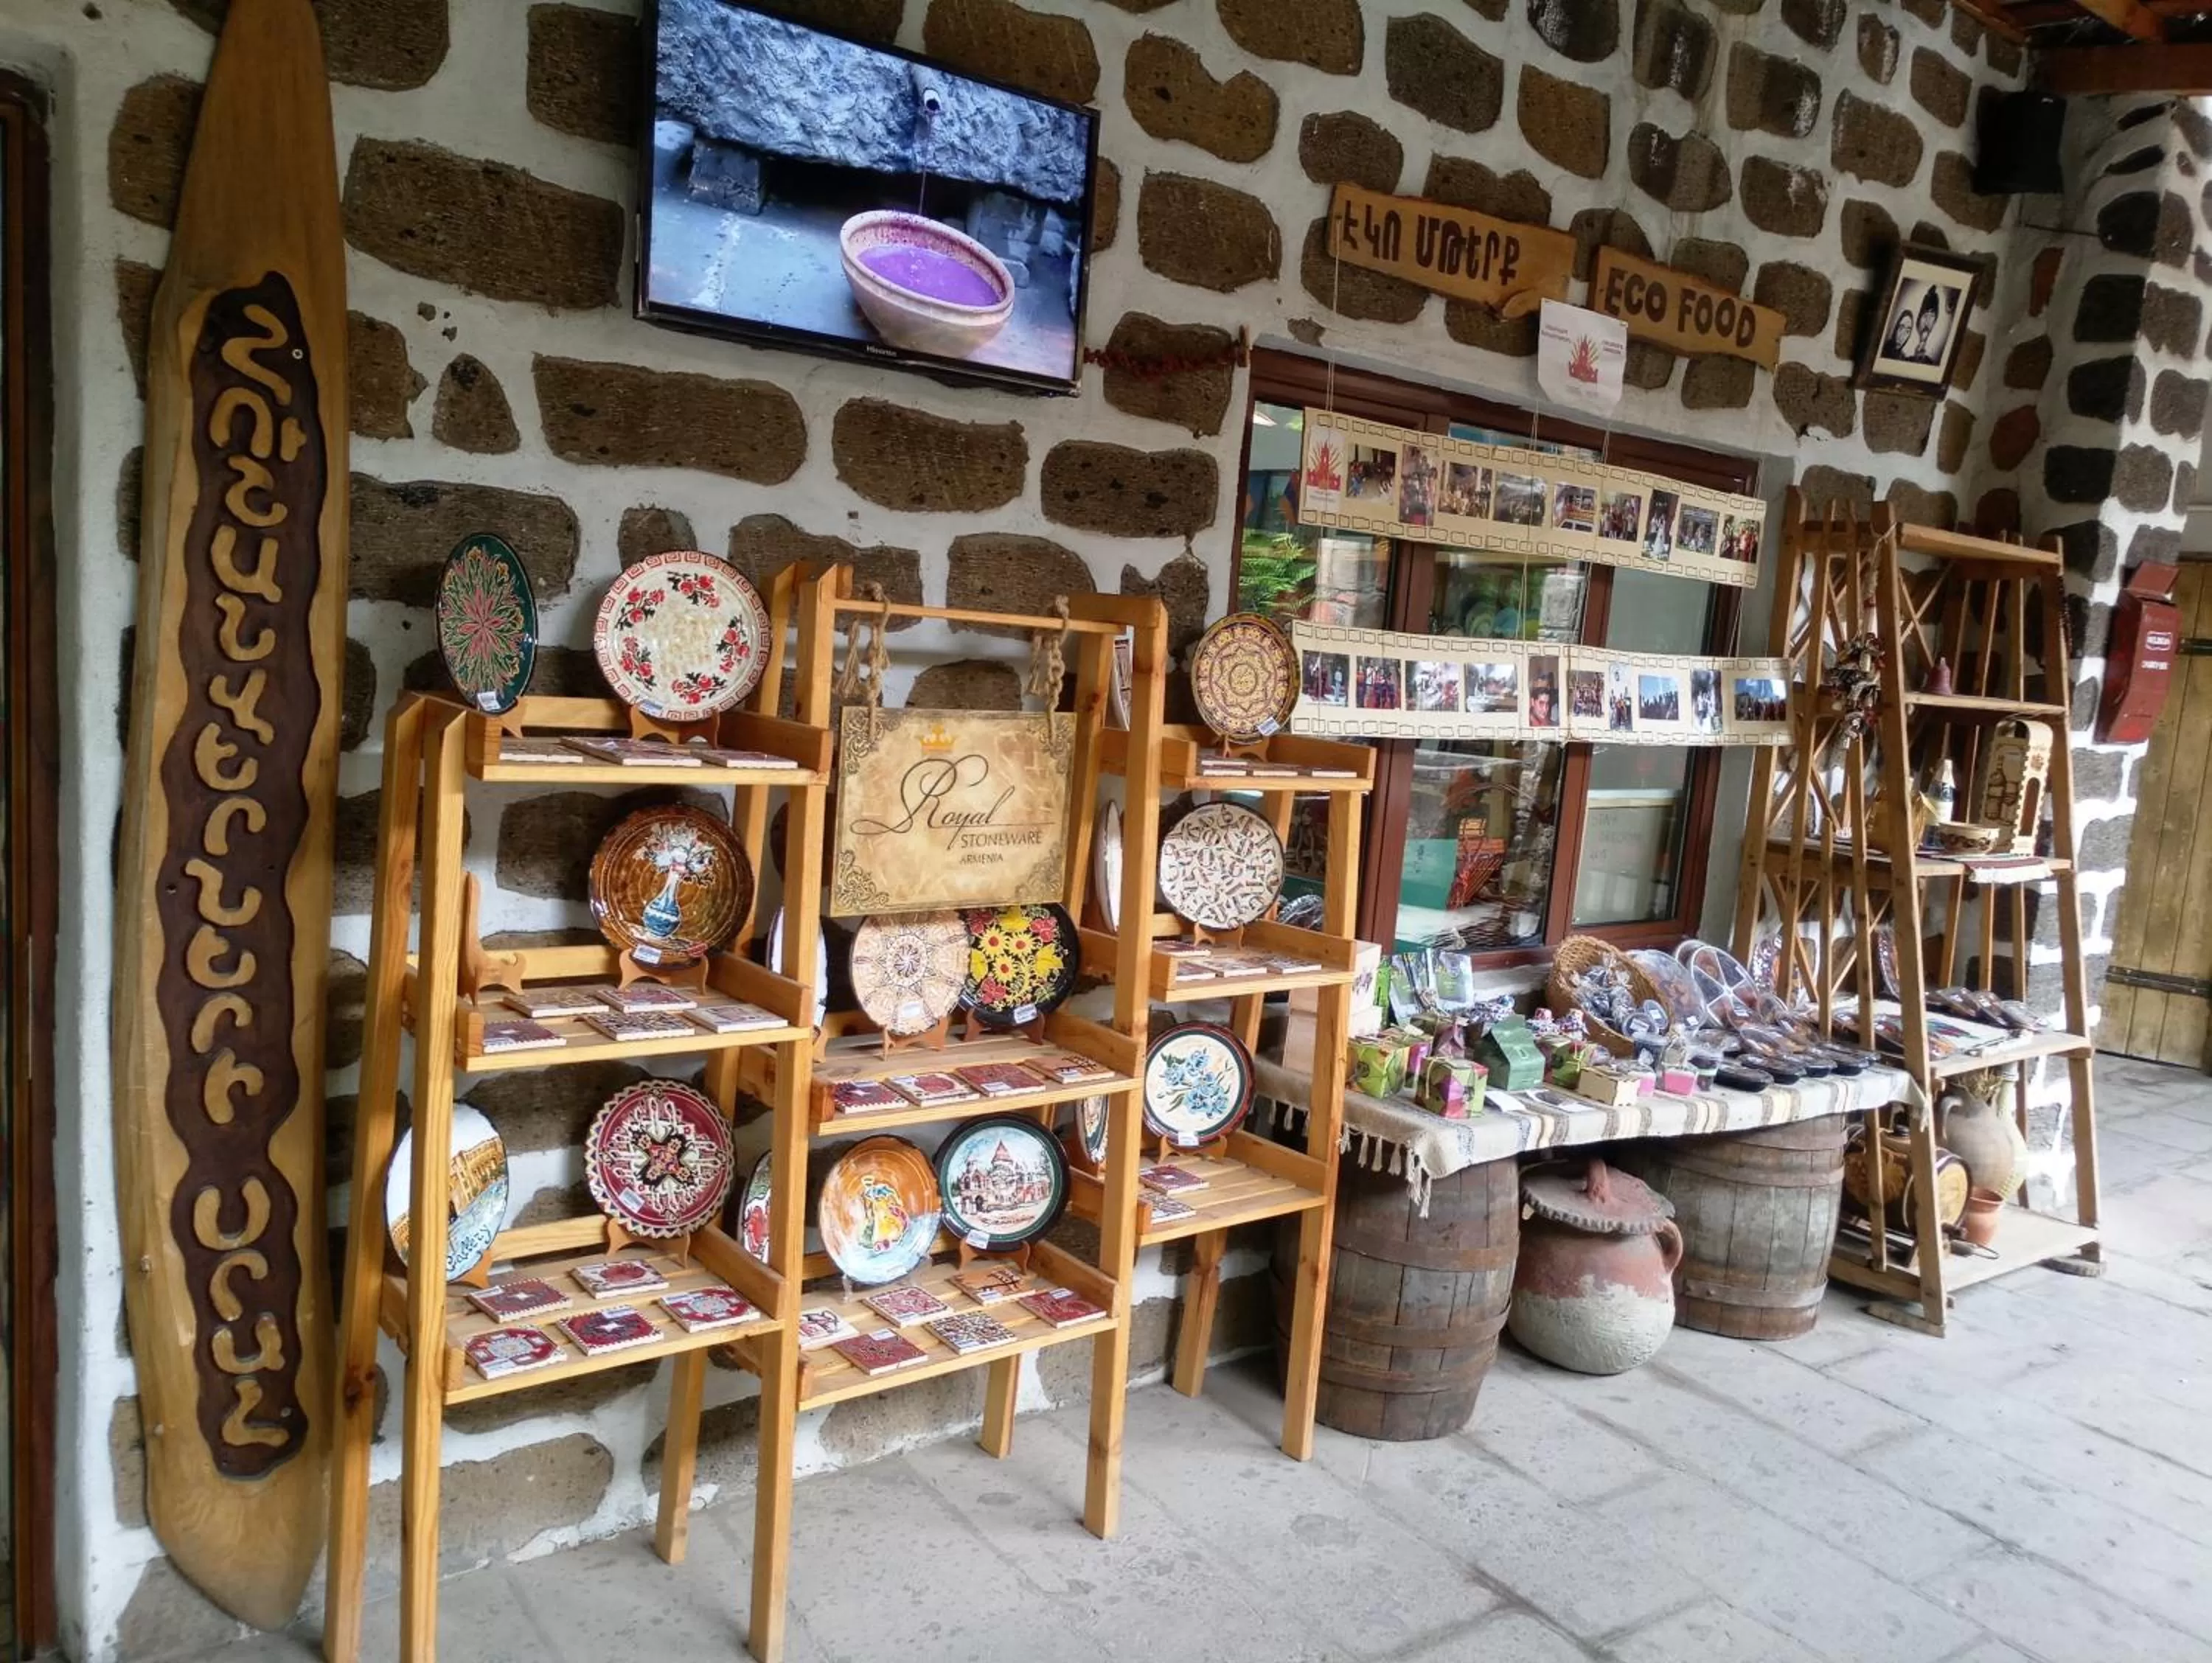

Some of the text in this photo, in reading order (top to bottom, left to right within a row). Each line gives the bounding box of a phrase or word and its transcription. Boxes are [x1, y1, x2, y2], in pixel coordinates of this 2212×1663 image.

[1604, 268, 1756, 348] ECO FOOD
[850, 754, 1015, 851] Royal
[959, 854, 1004, 865] ARMENIA
[961, 831, 1042, 849] STONEWARE
